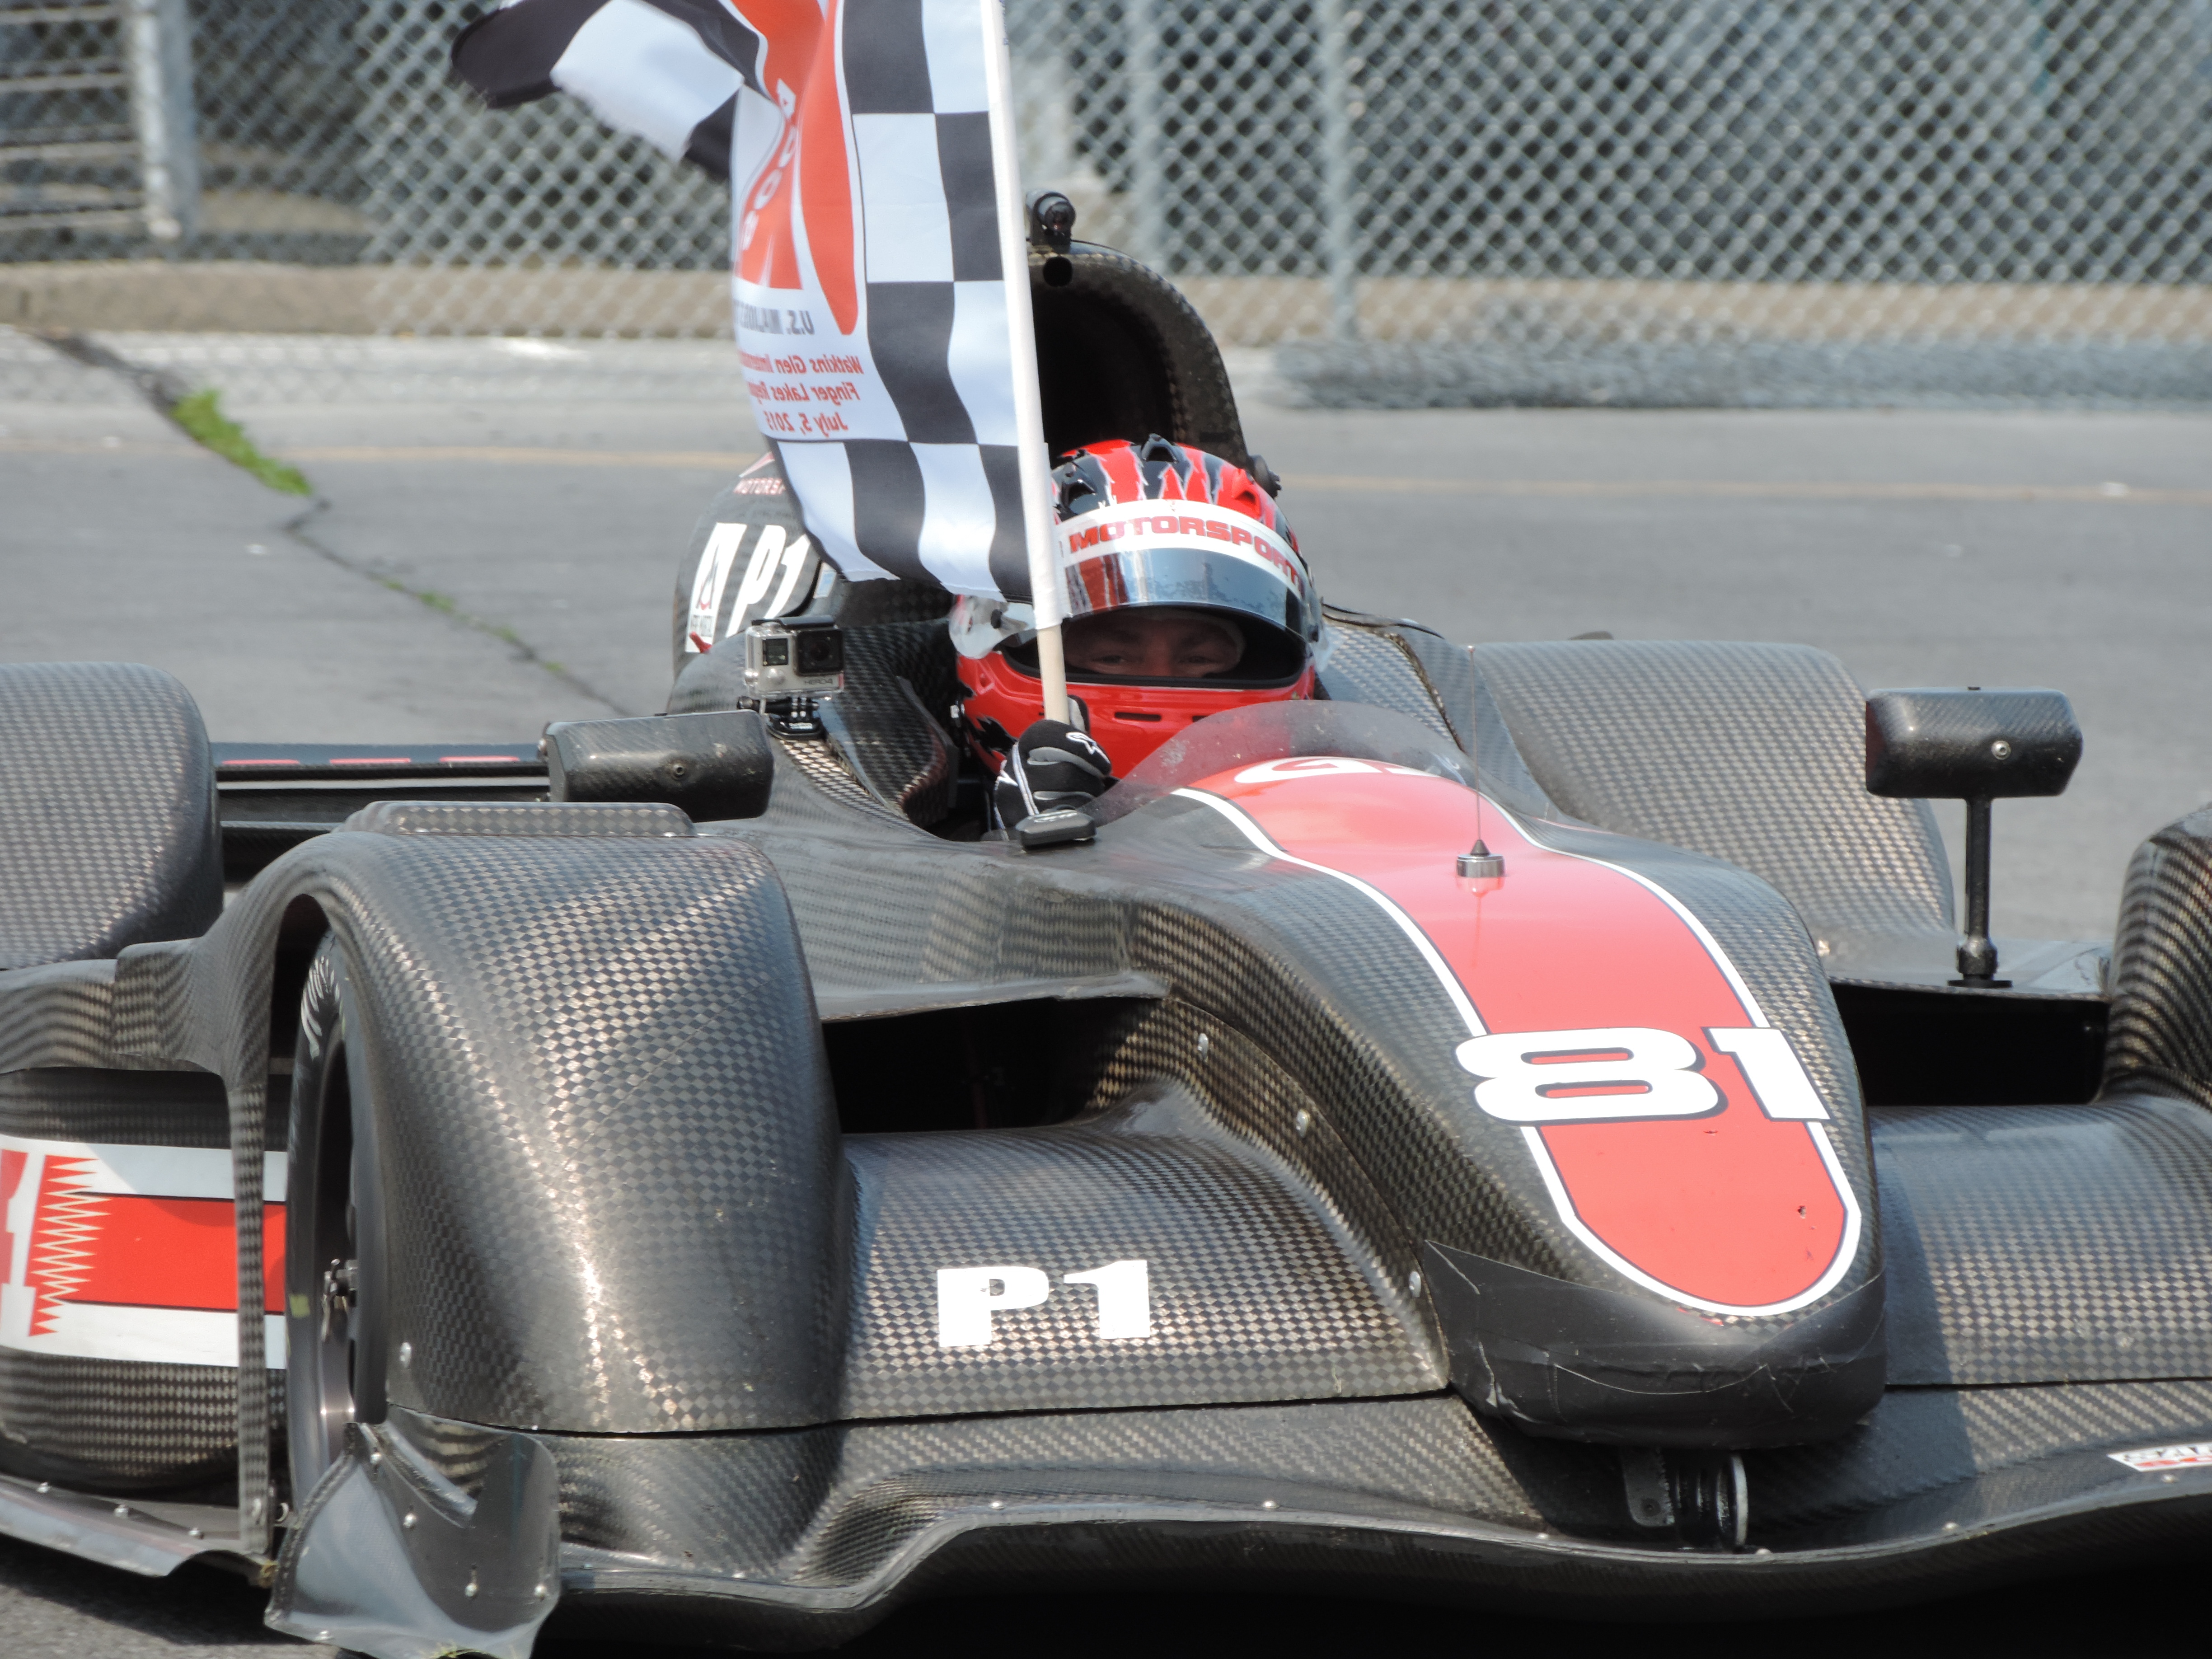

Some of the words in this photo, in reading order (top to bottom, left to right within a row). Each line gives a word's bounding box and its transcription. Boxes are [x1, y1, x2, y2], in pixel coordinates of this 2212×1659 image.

[726, 525, 811, 637] P1
[1456, 1027, 1831, 1124] 81
[937, 1260, 1150, 1347] P1
